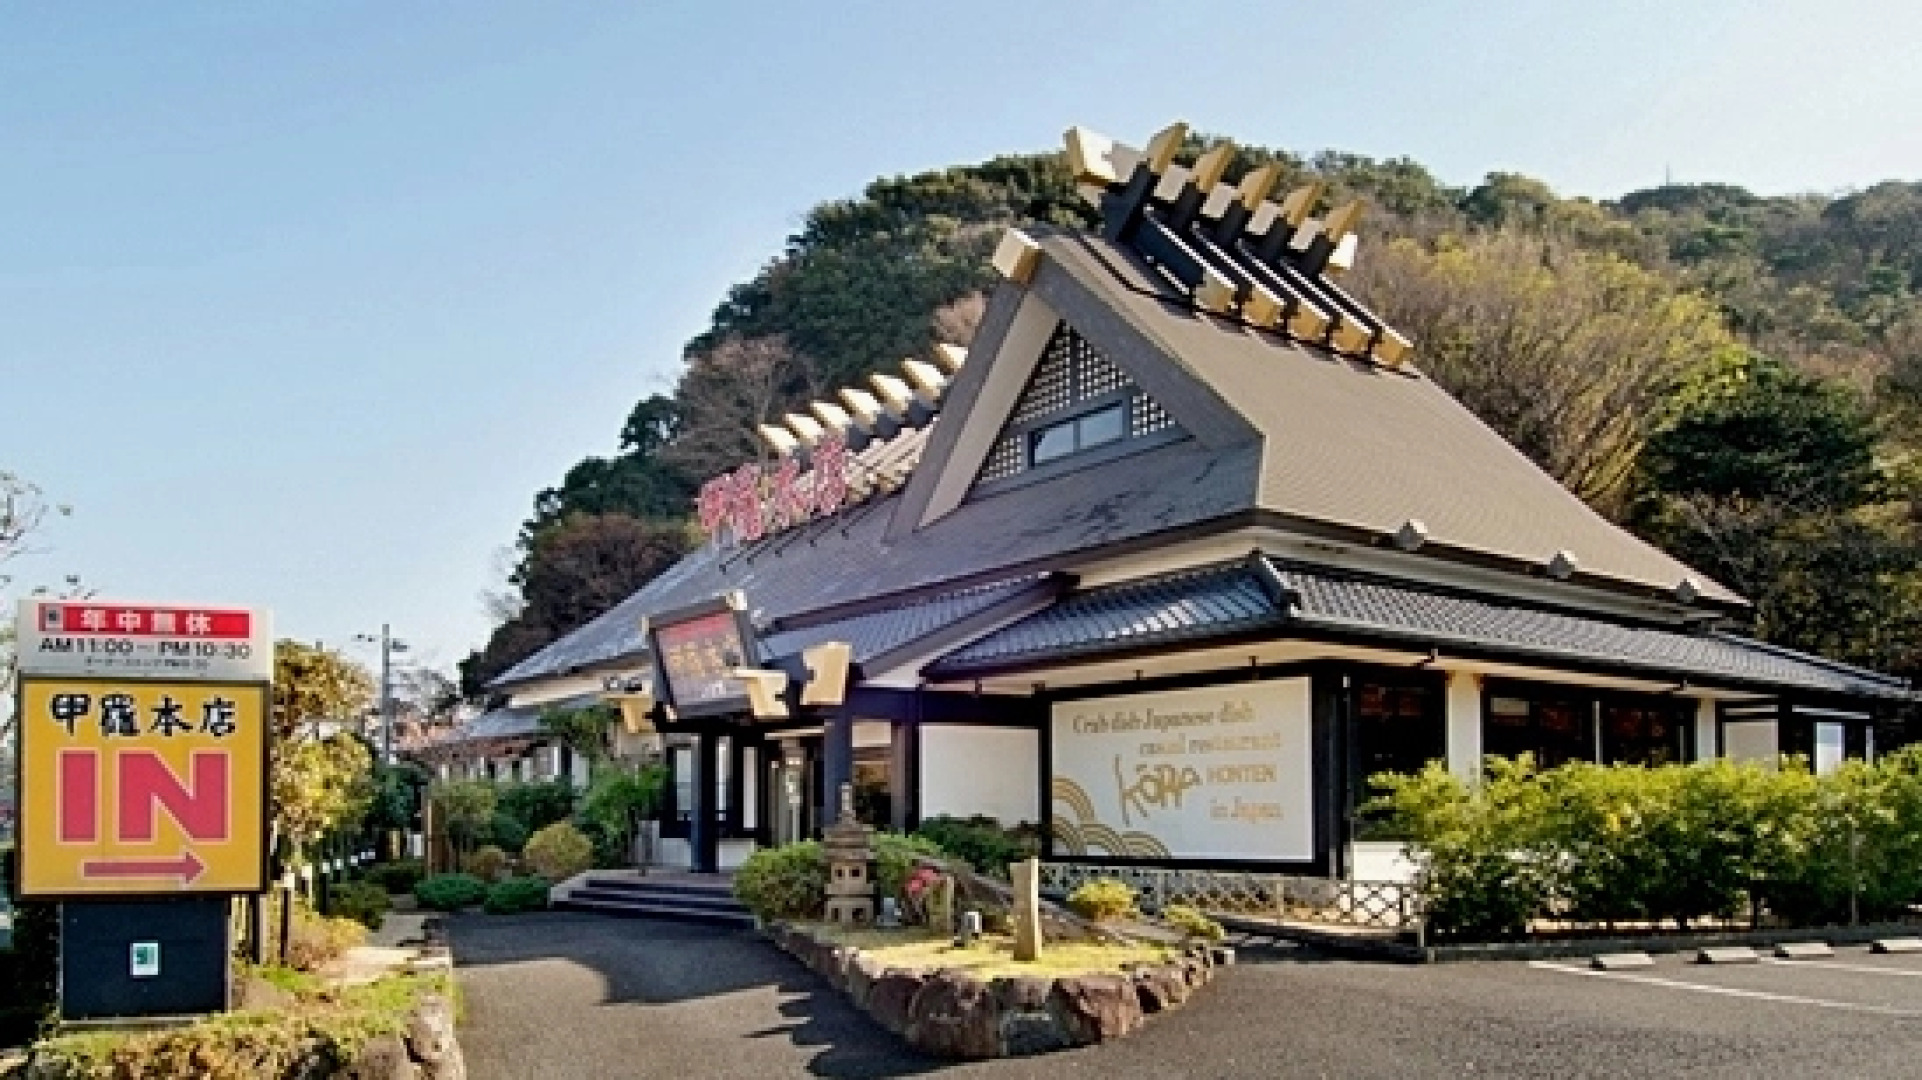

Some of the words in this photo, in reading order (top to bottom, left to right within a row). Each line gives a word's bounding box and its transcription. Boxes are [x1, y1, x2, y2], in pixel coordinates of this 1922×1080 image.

[50, 693, 237, 738] 甲羅本店
[1073, 713, 1108, 733] Crab
[1144, 707, 1214, 733] Japanese
[58, 749, 230, 844] IN
